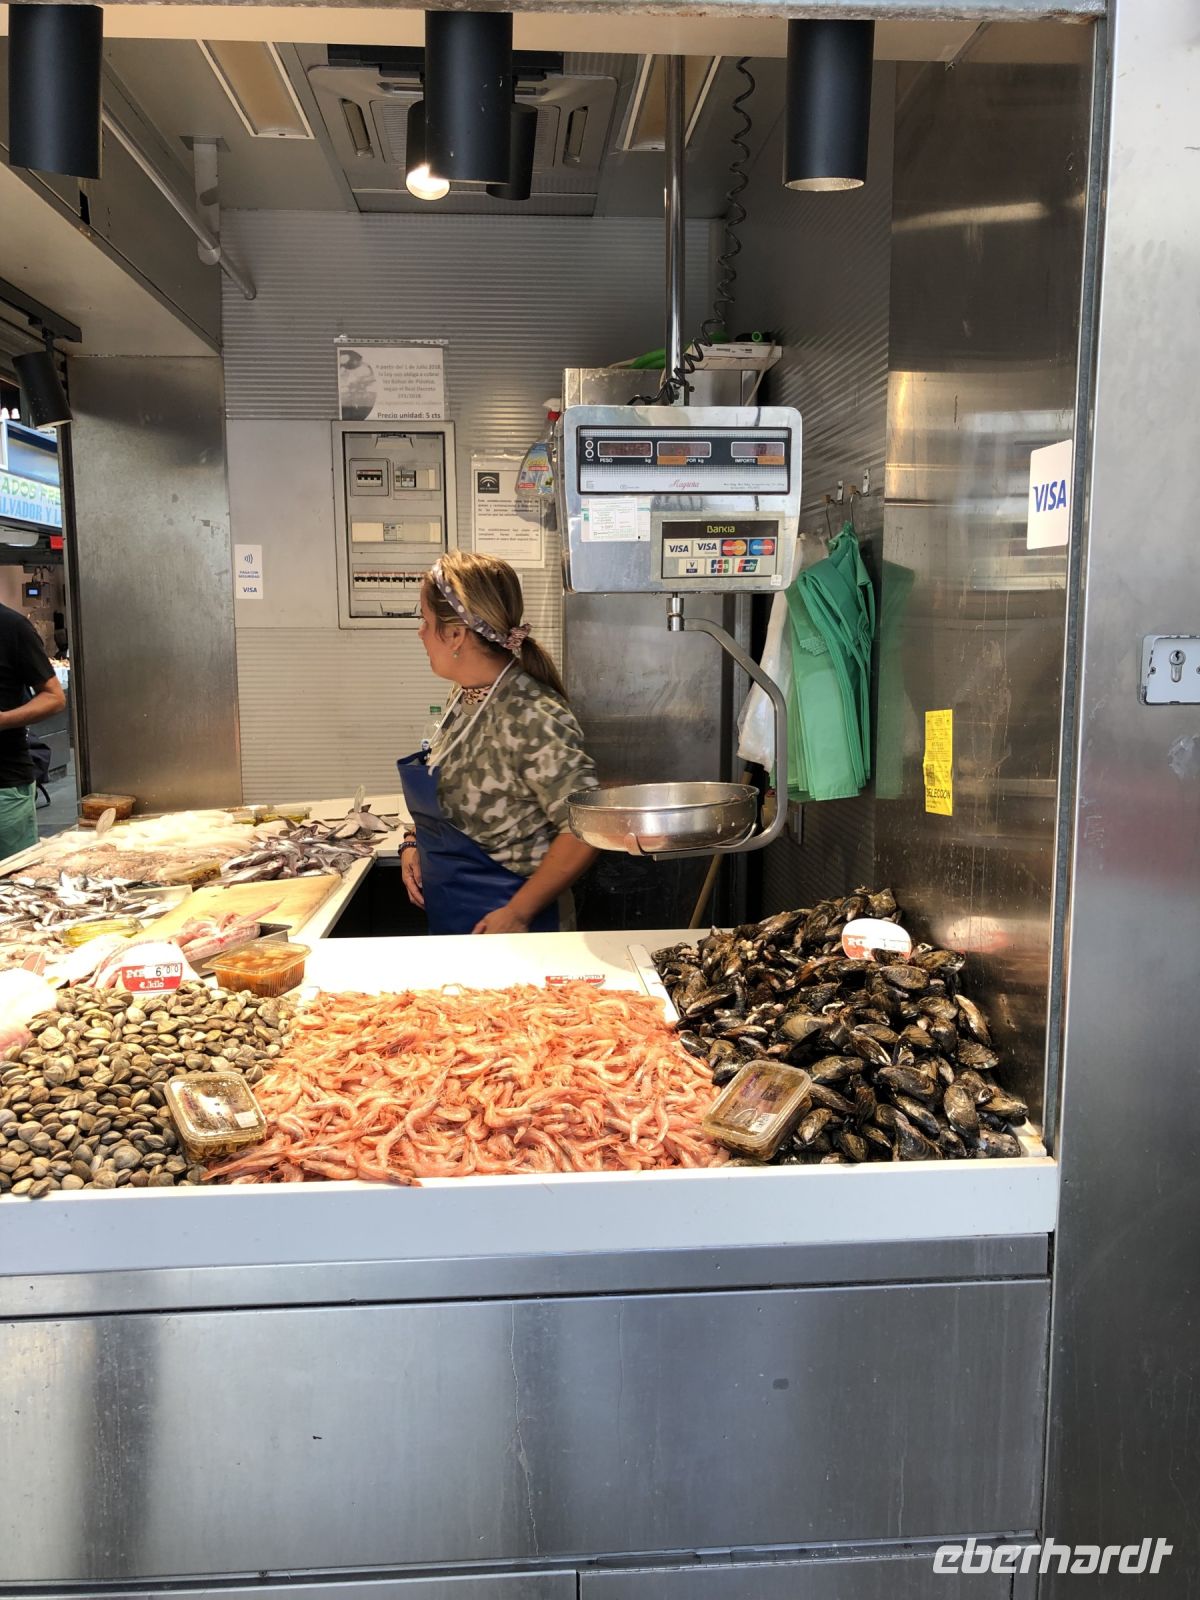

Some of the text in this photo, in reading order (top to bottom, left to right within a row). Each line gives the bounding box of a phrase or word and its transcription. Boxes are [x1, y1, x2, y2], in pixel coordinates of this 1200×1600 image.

[377, 411, 398, 419] Precio
[400, 411, 424, 419] unidad:
[1032, 480, 1066, 512] VISA
[706, 525, 736, 533] Bankia
[697, 543, 717, 551] VISA
